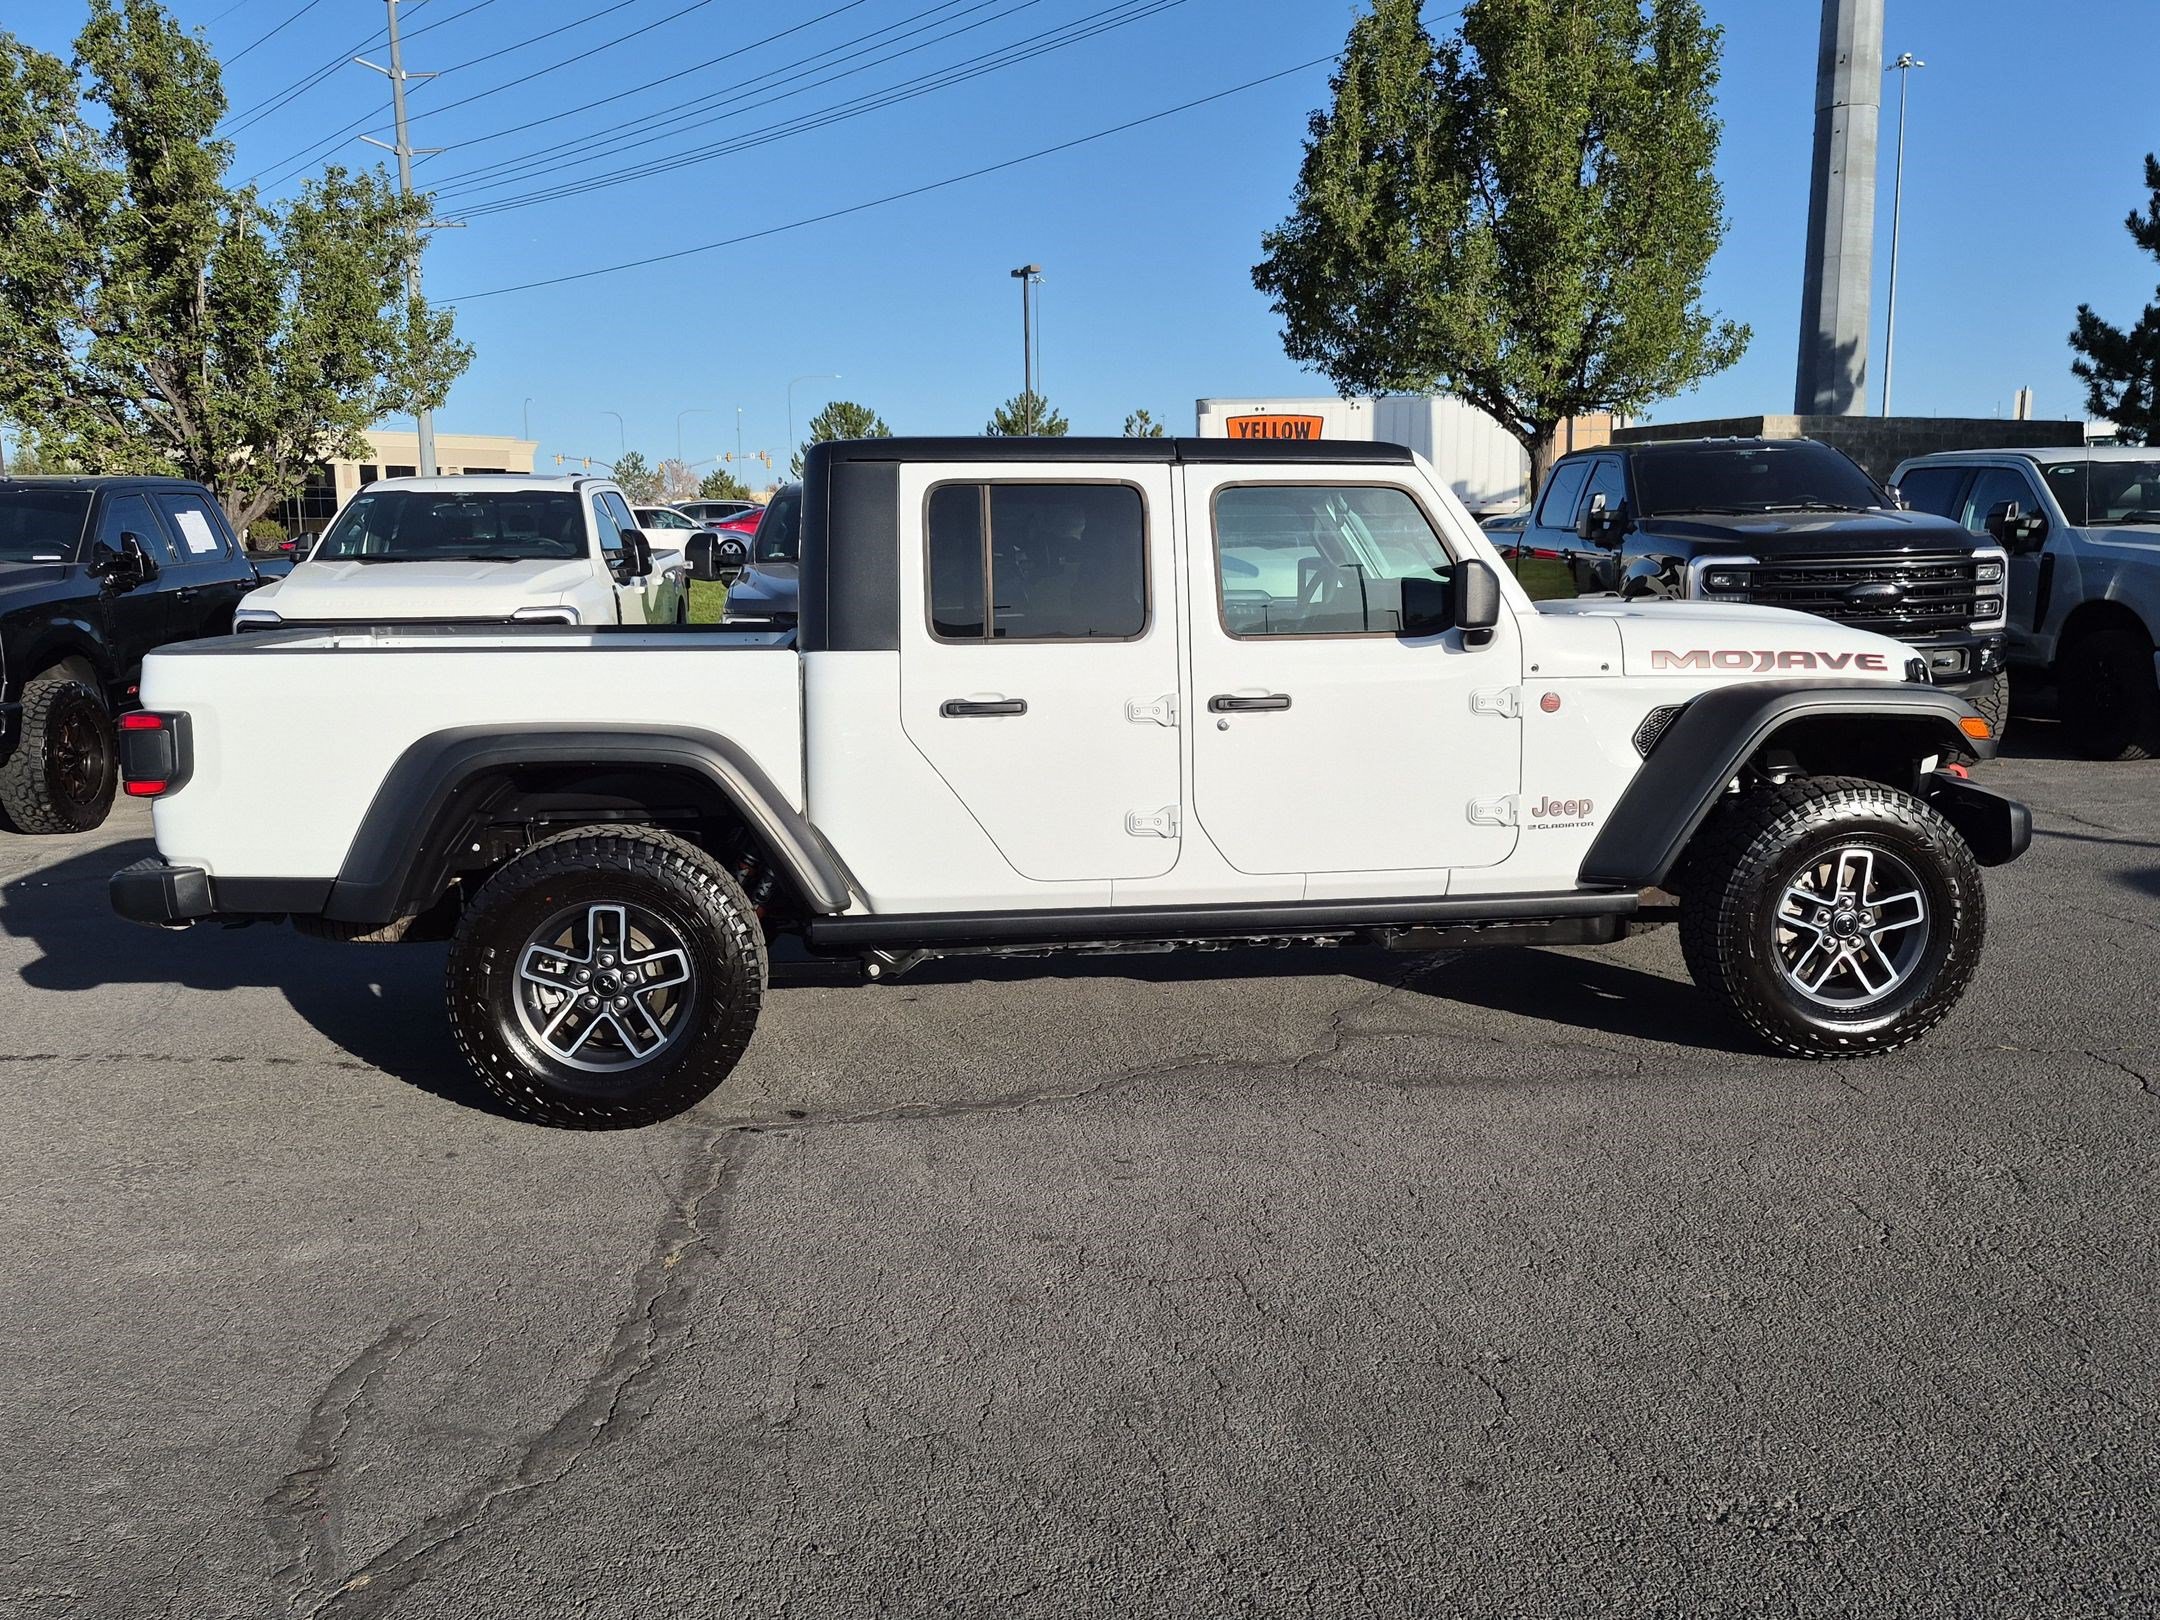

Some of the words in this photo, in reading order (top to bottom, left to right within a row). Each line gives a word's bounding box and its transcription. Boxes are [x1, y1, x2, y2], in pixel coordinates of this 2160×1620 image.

[1238, 421, 1312, 439] YELLOW
[1651, 650, 1888, 672] MOJAVE
[1532, 796, 1594, 818] Jeep
[1538, 821, 1594, 830] GLADIATOR
